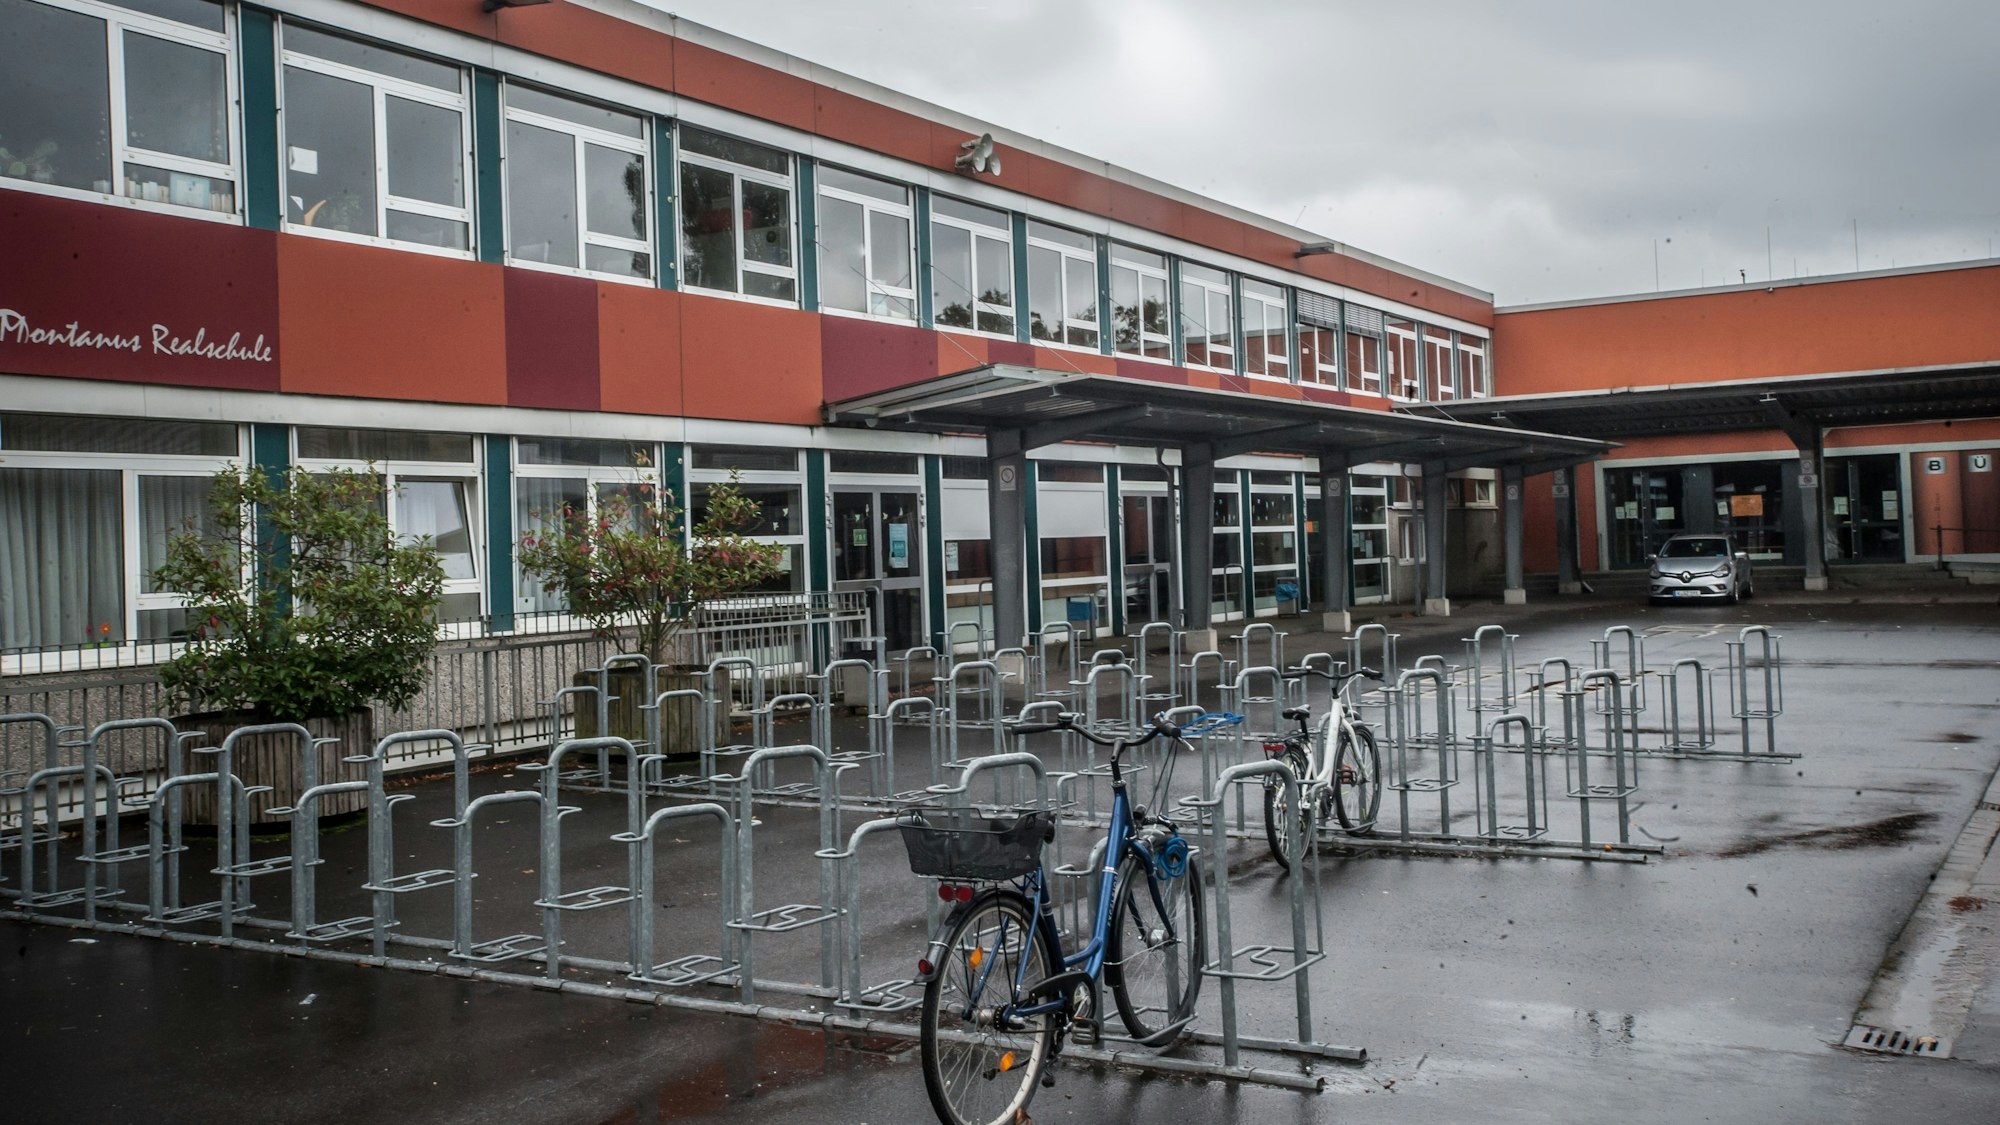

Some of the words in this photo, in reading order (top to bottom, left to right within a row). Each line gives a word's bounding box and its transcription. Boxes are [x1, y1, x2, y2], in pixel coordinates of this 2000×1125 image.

[0, 309, 141, 352] Montanus
[152, 324, 272, 362] Realschule
[1929, 460, 1941, 471] B
[1974, 455, 1986, 469] Ü
